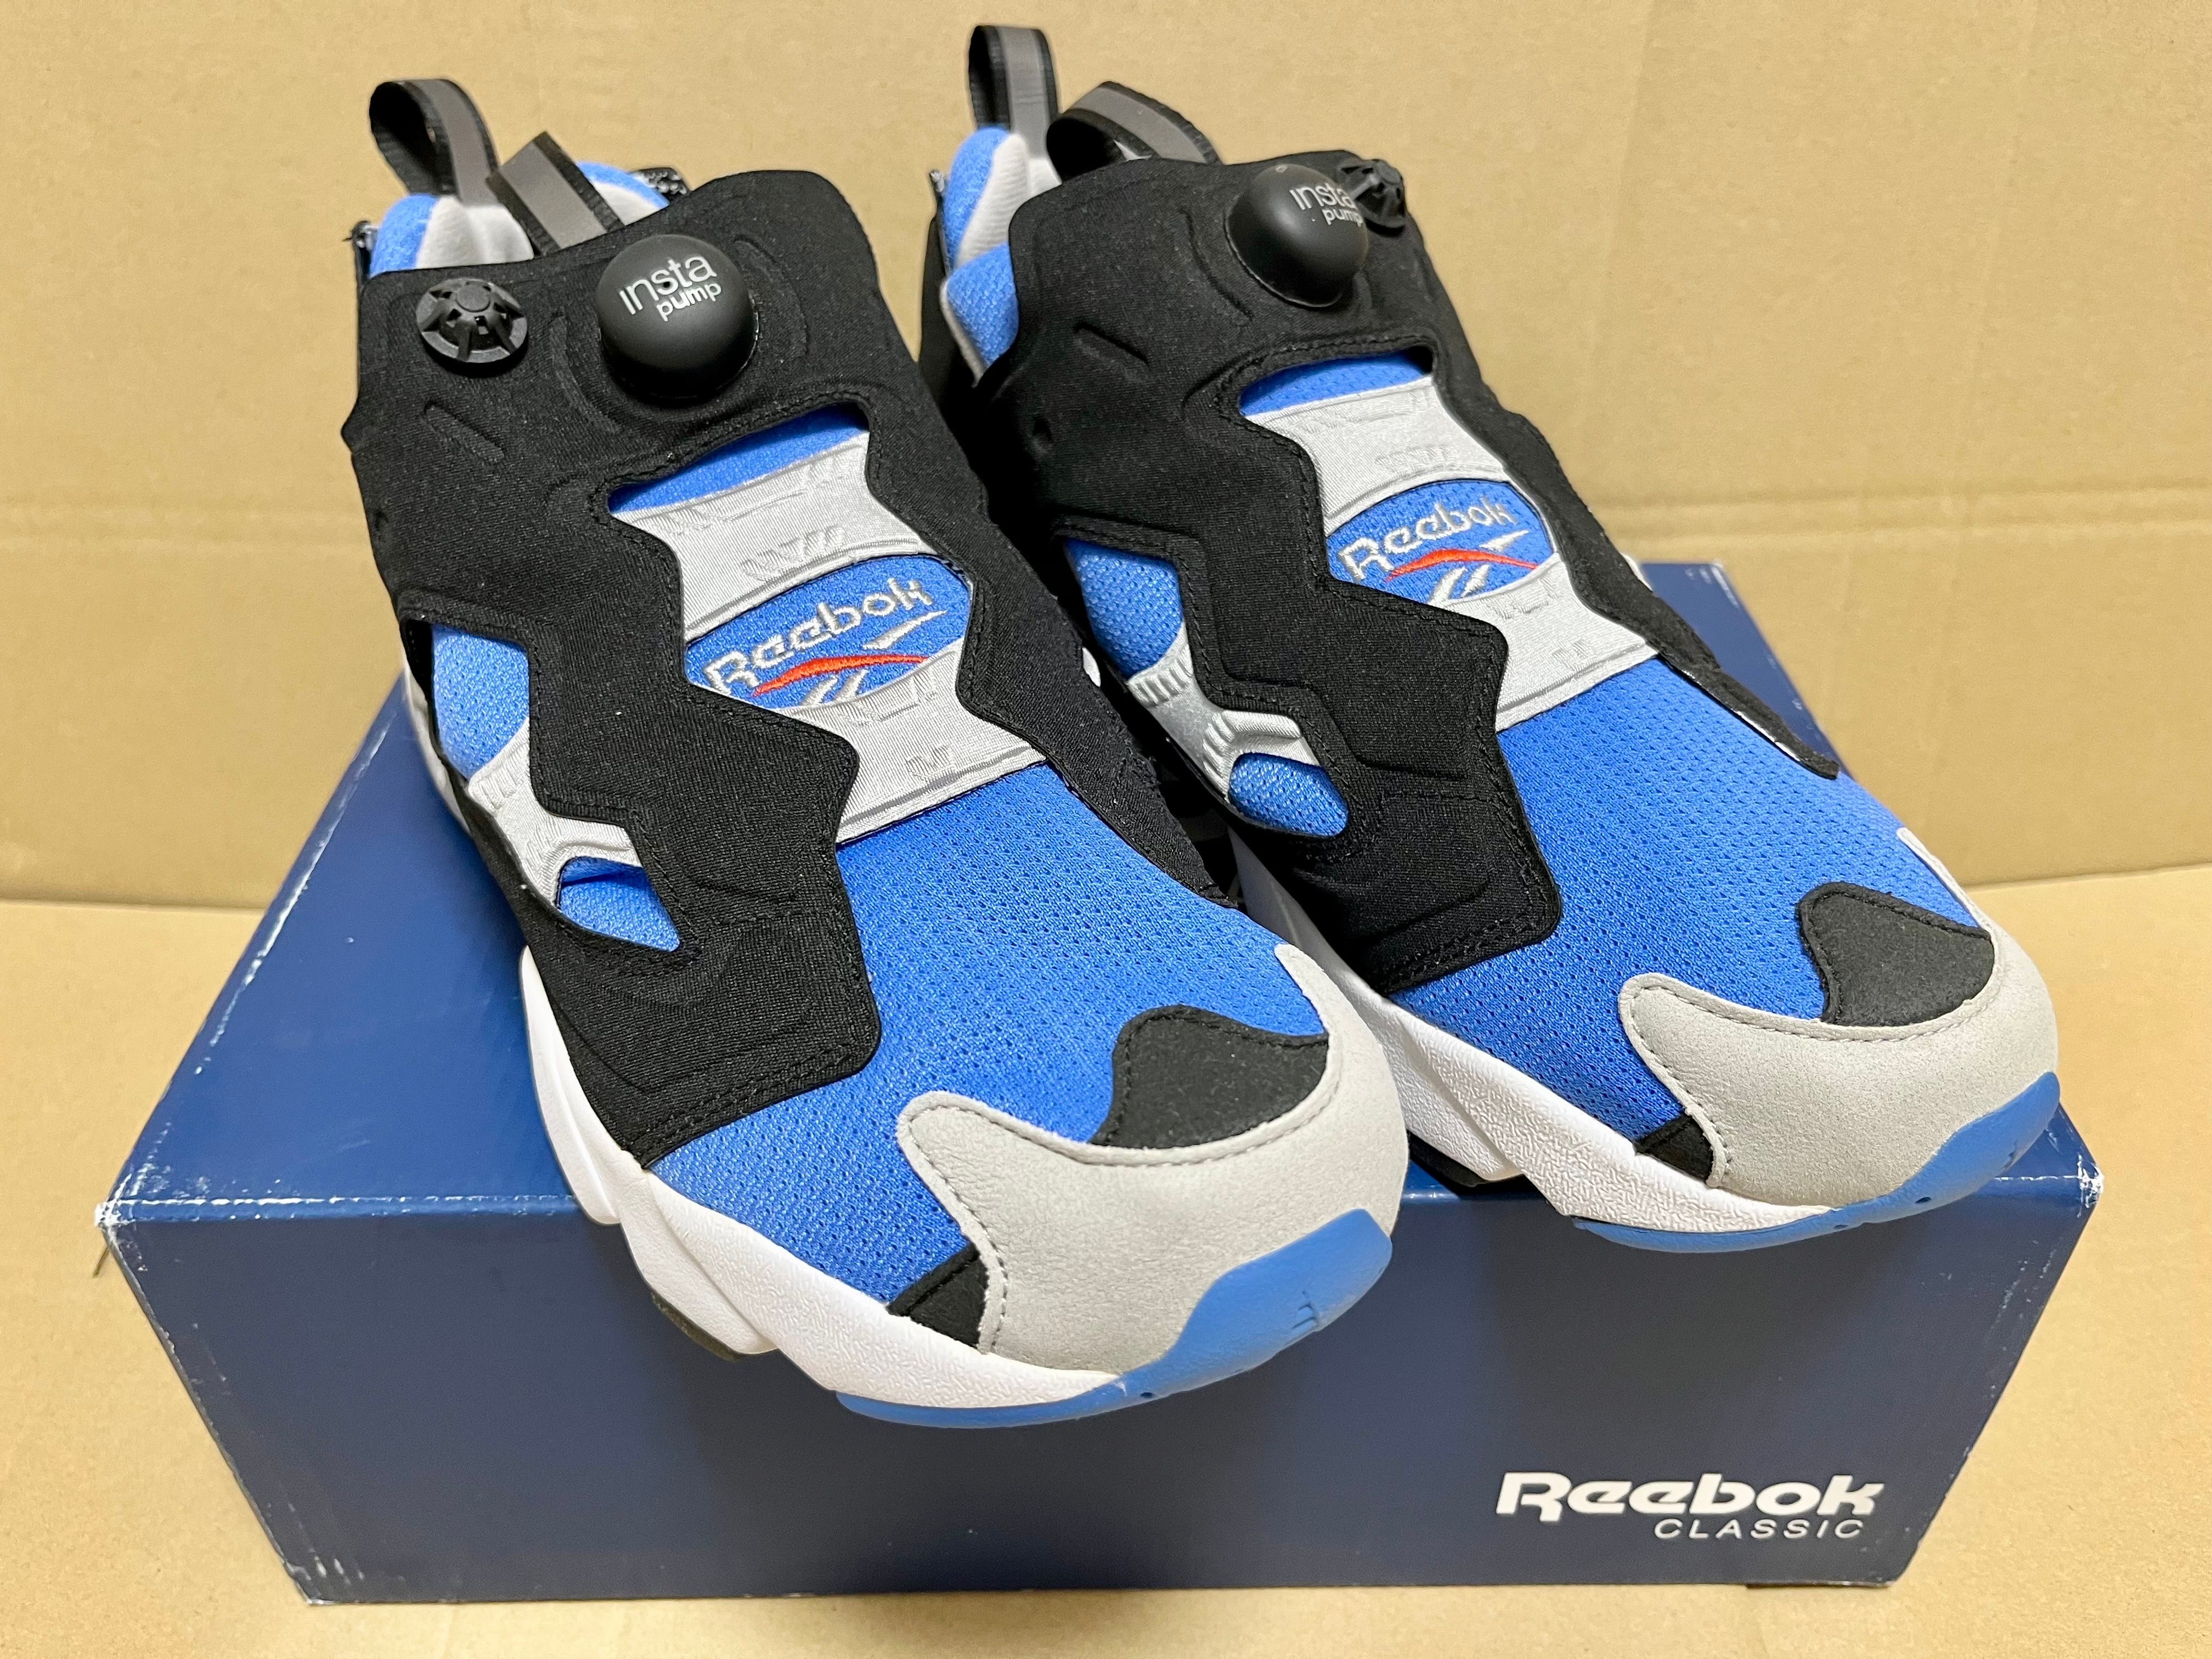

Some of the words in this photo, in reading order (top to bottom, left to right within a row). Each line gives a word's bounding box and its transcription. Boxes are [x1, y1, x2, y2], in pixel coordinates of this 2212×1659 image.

[1322, 208, 1363, 227] pump
[656, 283, 722, 321] pump
[1337, 496, 1519, 581] Reebok
[703, 577, 933, 695] Reebok
[1496, 1471, 1884, 1522] Reebok
[1654, 1518, 1864, 1538] CLASSIC
